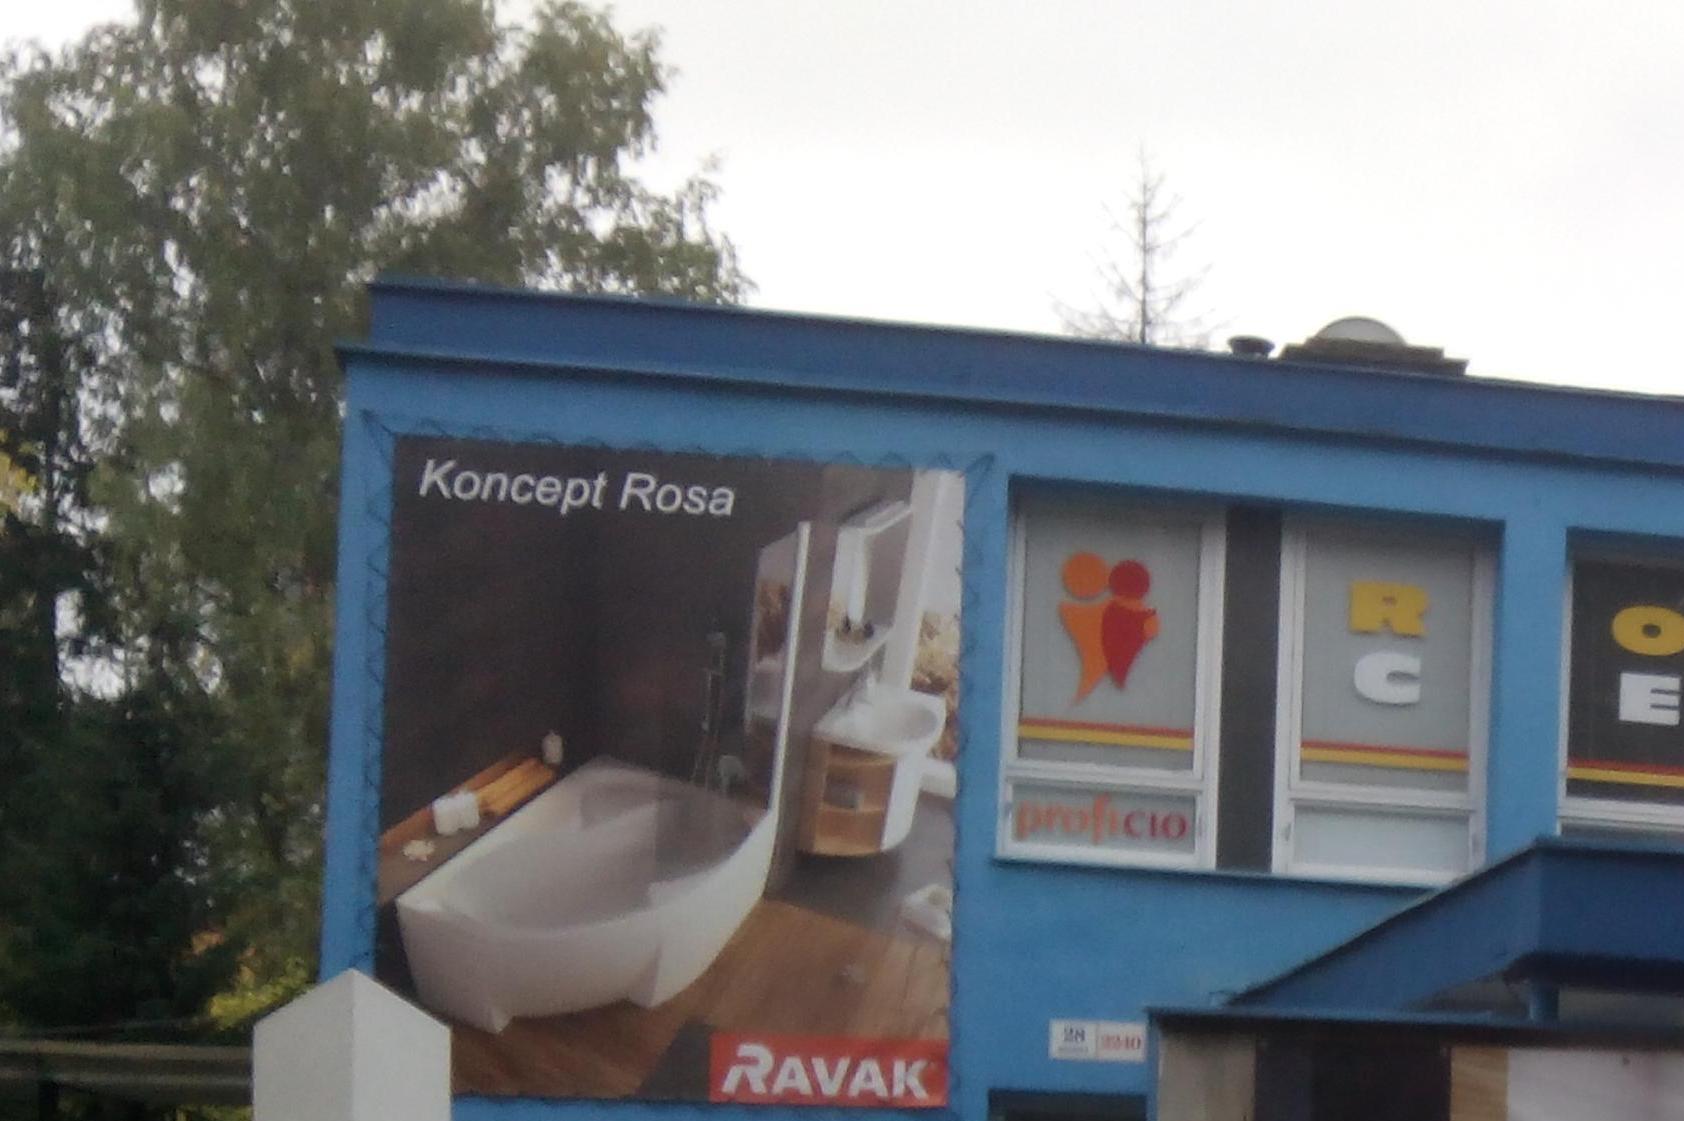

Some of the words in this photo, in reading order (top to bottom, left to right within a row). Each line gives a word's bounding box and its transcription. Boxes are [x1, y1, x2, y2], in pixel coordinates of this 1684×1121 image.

[418, 458, 607, 516] Koncept
[619, 472, 735, 516] Rosa
[1015, 791, 1190, 845] proficio
[721, 1042, 930, 1100] RAVAK
